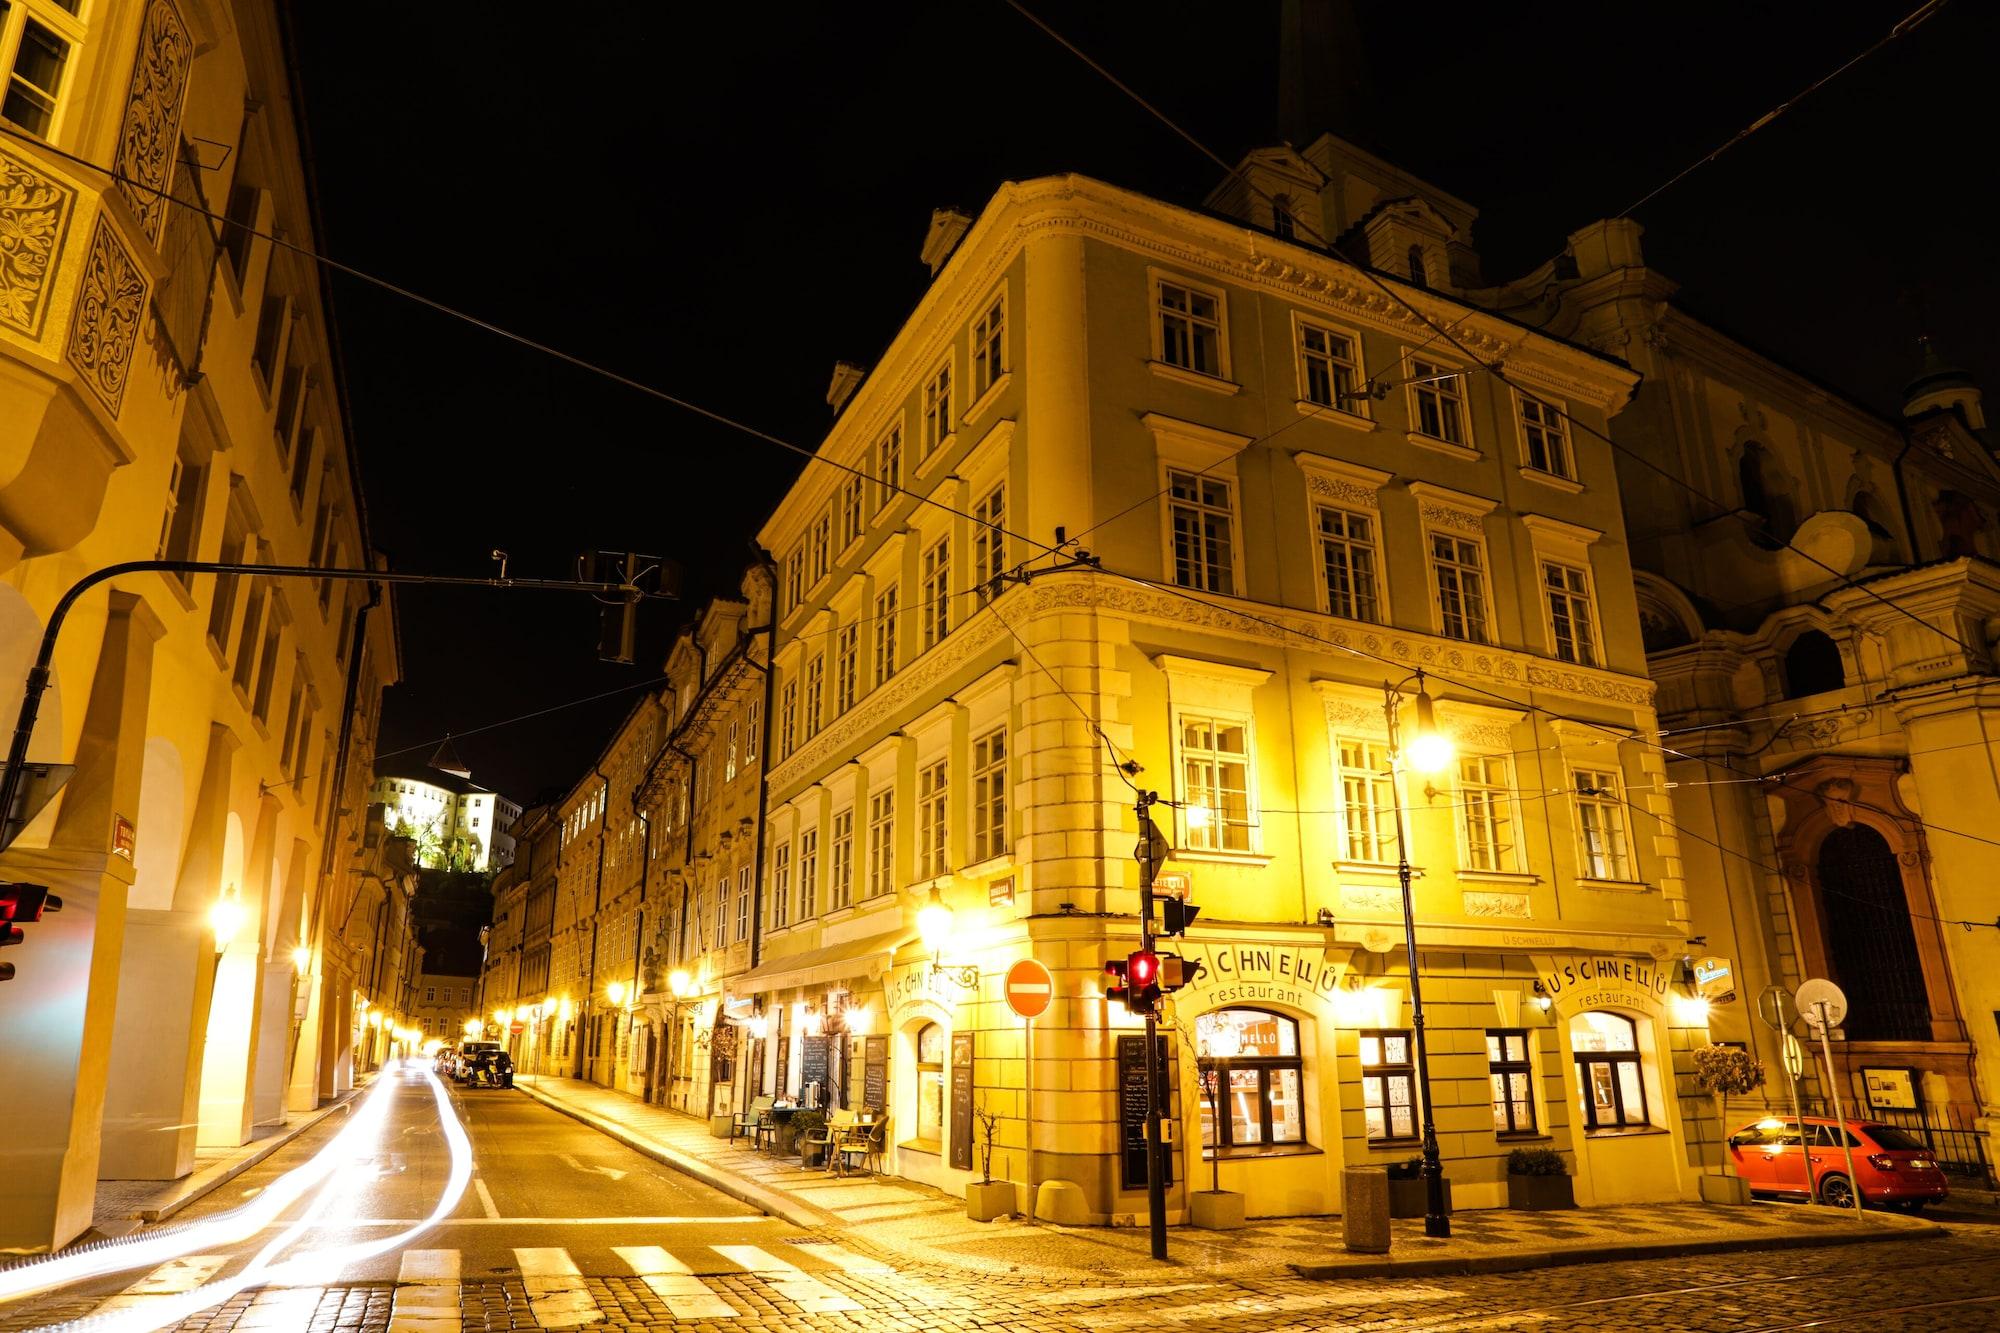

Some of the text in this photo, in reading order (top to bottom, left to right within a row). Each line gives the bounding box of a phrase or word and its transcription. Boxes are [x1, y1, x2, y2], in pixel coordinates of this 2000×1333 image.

[1548, 973, 1561, 993] U
[1564, 960, 1667, 995] SCHNELLŮ
[1209, 984, 1303, 1006] restaurant
[1579, 991, 1646, 1010] restaurant
